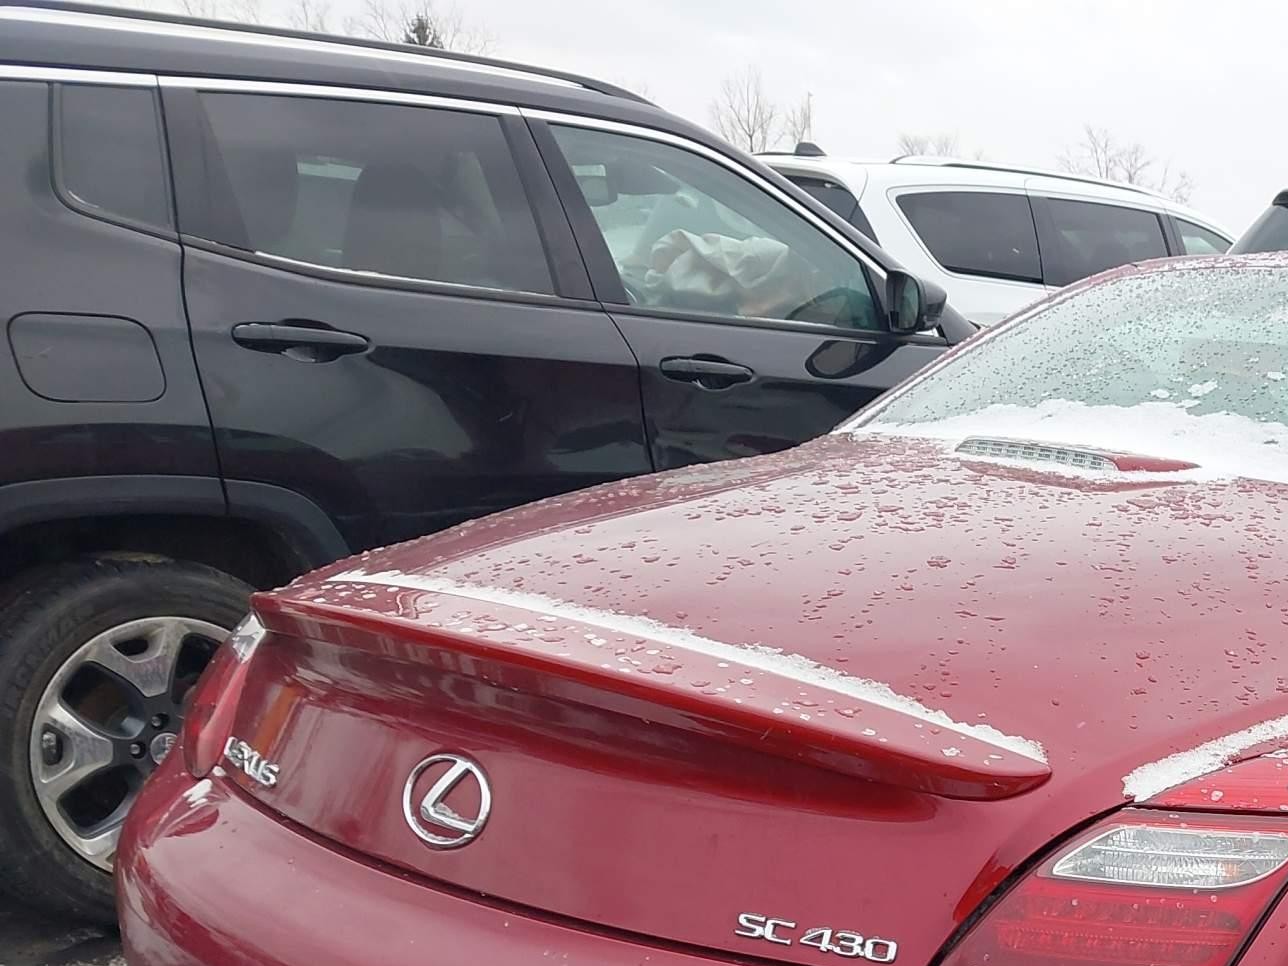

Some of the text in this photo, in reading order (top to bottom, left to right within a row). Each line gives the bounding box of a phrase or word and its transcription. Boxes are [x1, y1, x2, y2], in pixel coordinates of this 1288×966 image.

[223, 736, 280, 786] LEXUS
[734, 911, 899, 963] SC 430
